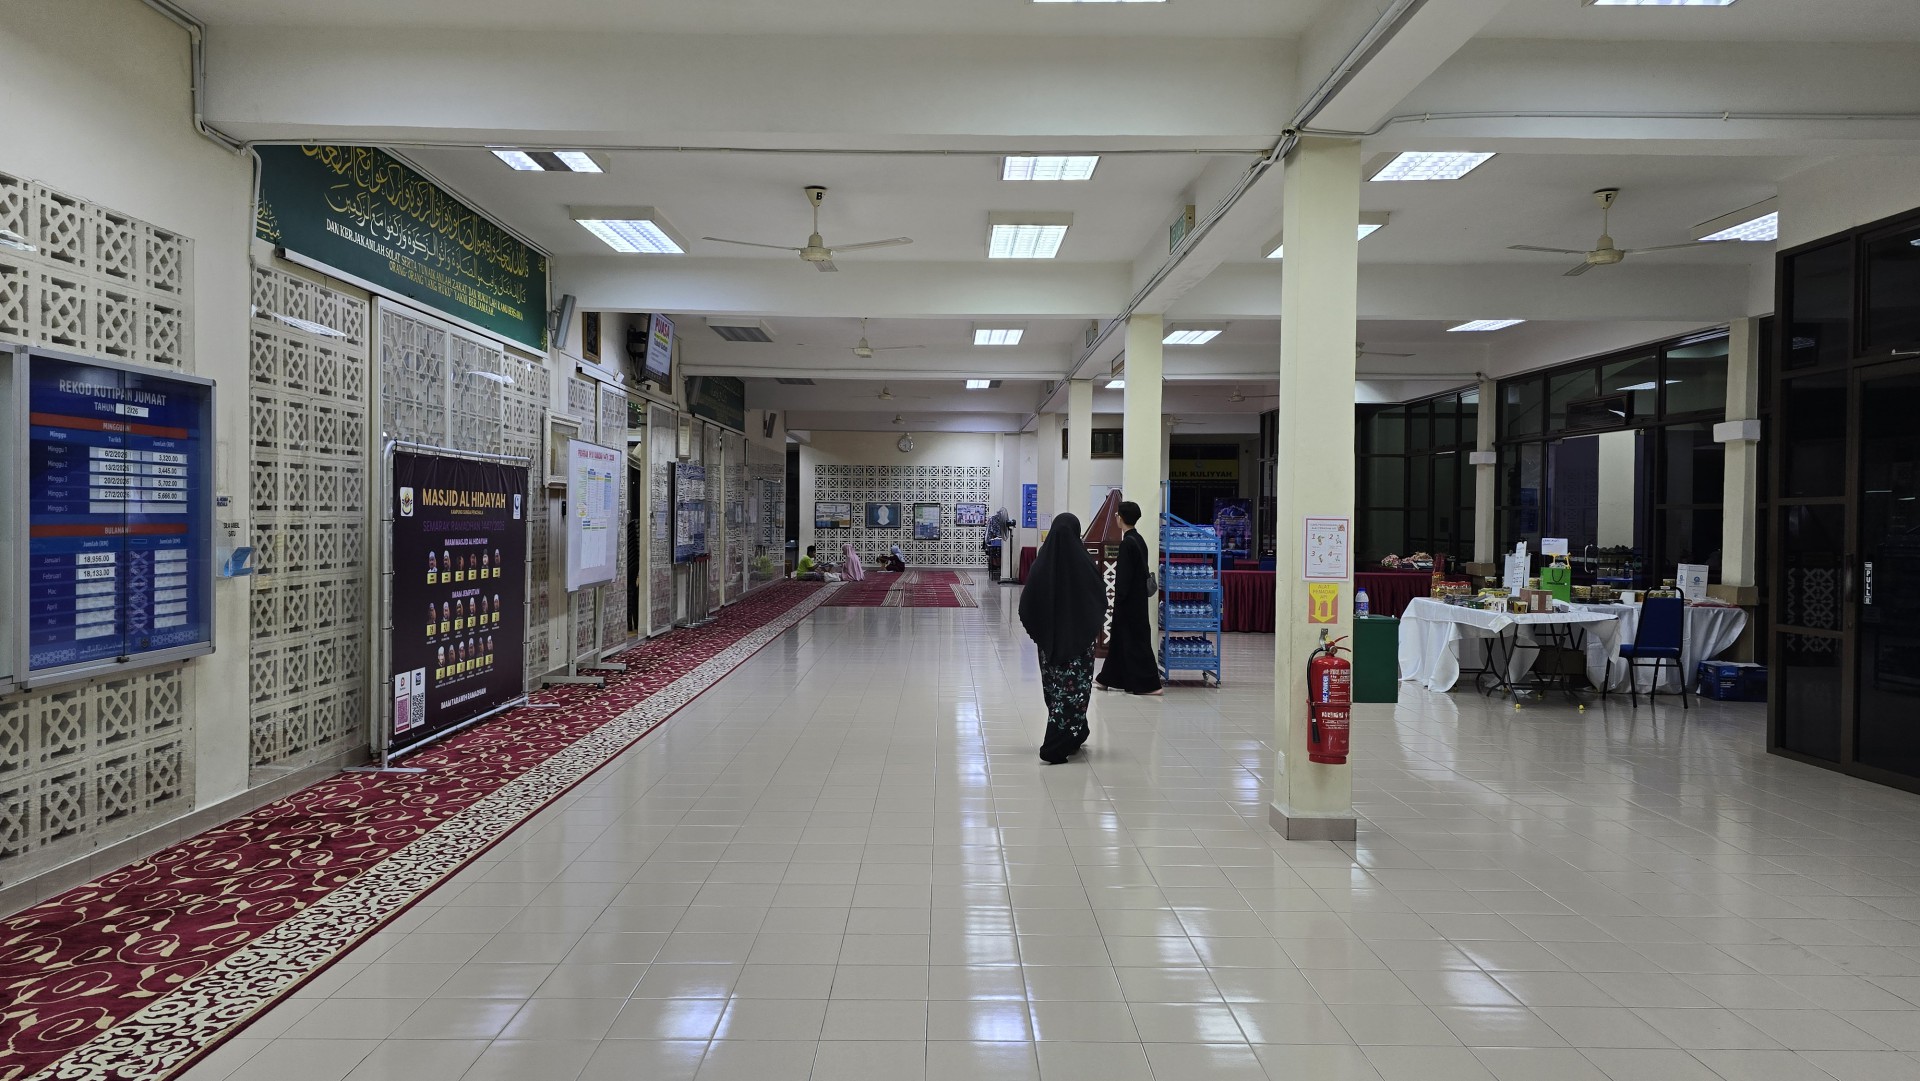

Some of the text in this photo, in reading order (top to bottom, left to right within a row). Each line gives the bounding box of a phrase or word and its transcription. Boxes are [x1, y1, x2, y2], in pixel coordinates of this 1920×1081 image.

[326, 218, 340, 235] DAN
[339, 224, 385, 257] KERJAKANLAH
[385, 247, 401, 263] SOLAT
[401, 255, 417, 271] SERTA
[407, 270, 424, 285] ORANG
[59, 379, 167, 407] REKOD KUTIPAN JUMAAT
[94, 401, 115, 413] TAHUN
[102, 422, 131, 432] MINGGUAN
[49, 430, 67, 439] Minggu
[47, 446, 64, 454] Minggu
[47, 460, 64, 469] Minggu
[47, 475, 64, 484] Minggu
[47, 490, 64, 499] Minggu
[422, 488, 506, 509] MASJID AL HIDAYAH
[47, 505, 64, 513] Minggu
[104, 526, 130, 535] BULANAN
[422, 520, 450, 532] SEMARAK
[450, 520, 481, 531] RAMADHAN
[444, 538, 456, 546] IMAM
[455, 538, 468, 546] MASJID
[451, 590, 463, 599] IMAM
[46, 603, 58, 611] April
[440, 700, 452, 710] IMAM
